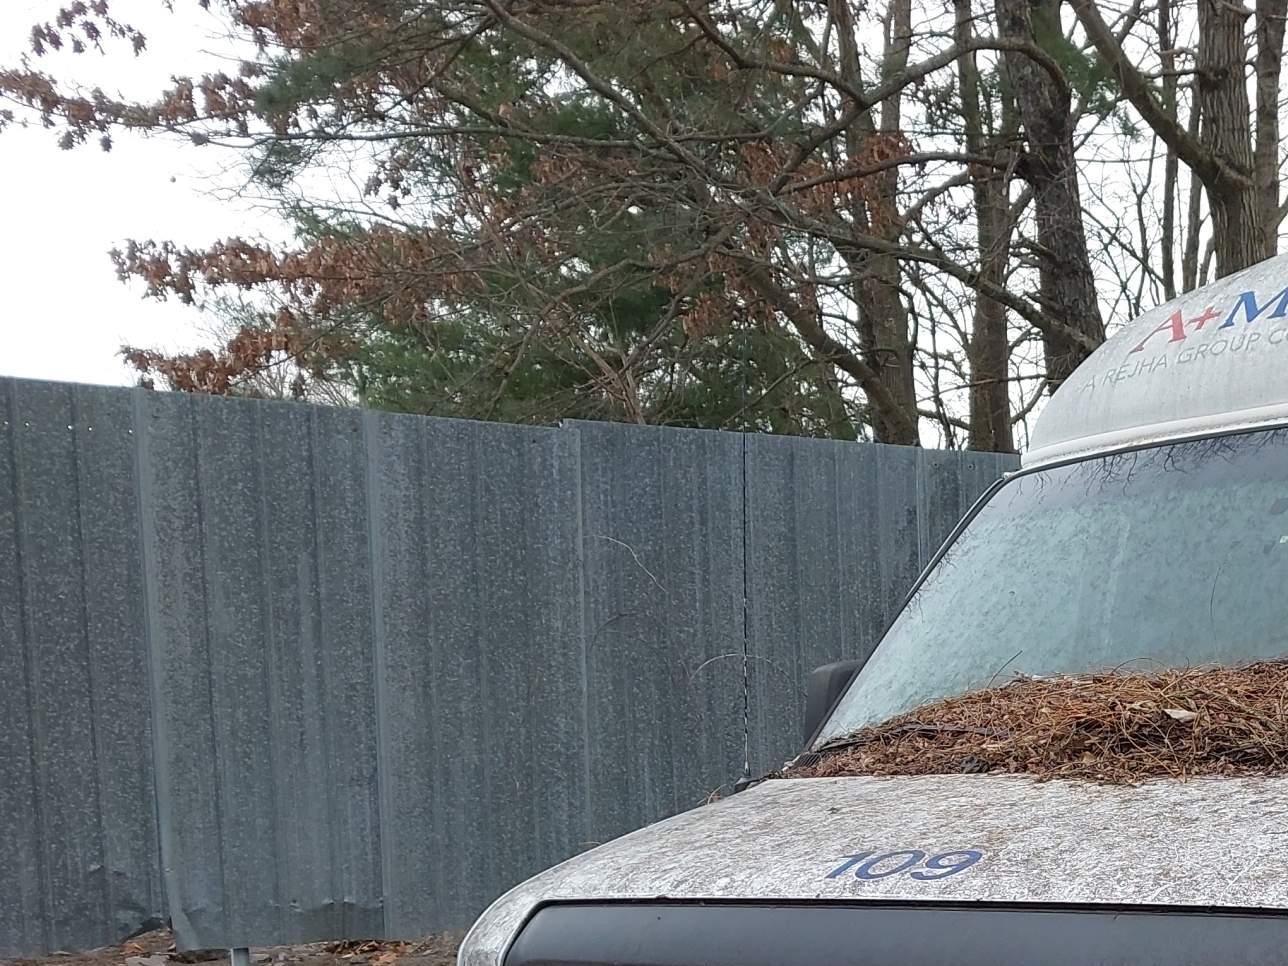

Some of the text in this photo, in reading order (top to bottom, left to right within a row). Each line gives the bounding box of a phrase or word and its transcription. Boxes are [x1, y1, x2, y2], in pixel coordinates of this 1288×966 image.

[1102, 353, 1168, 385] REJHA
[1176, 334, 1258, 363] GROUP
[825, 850, 982, 880] 109
